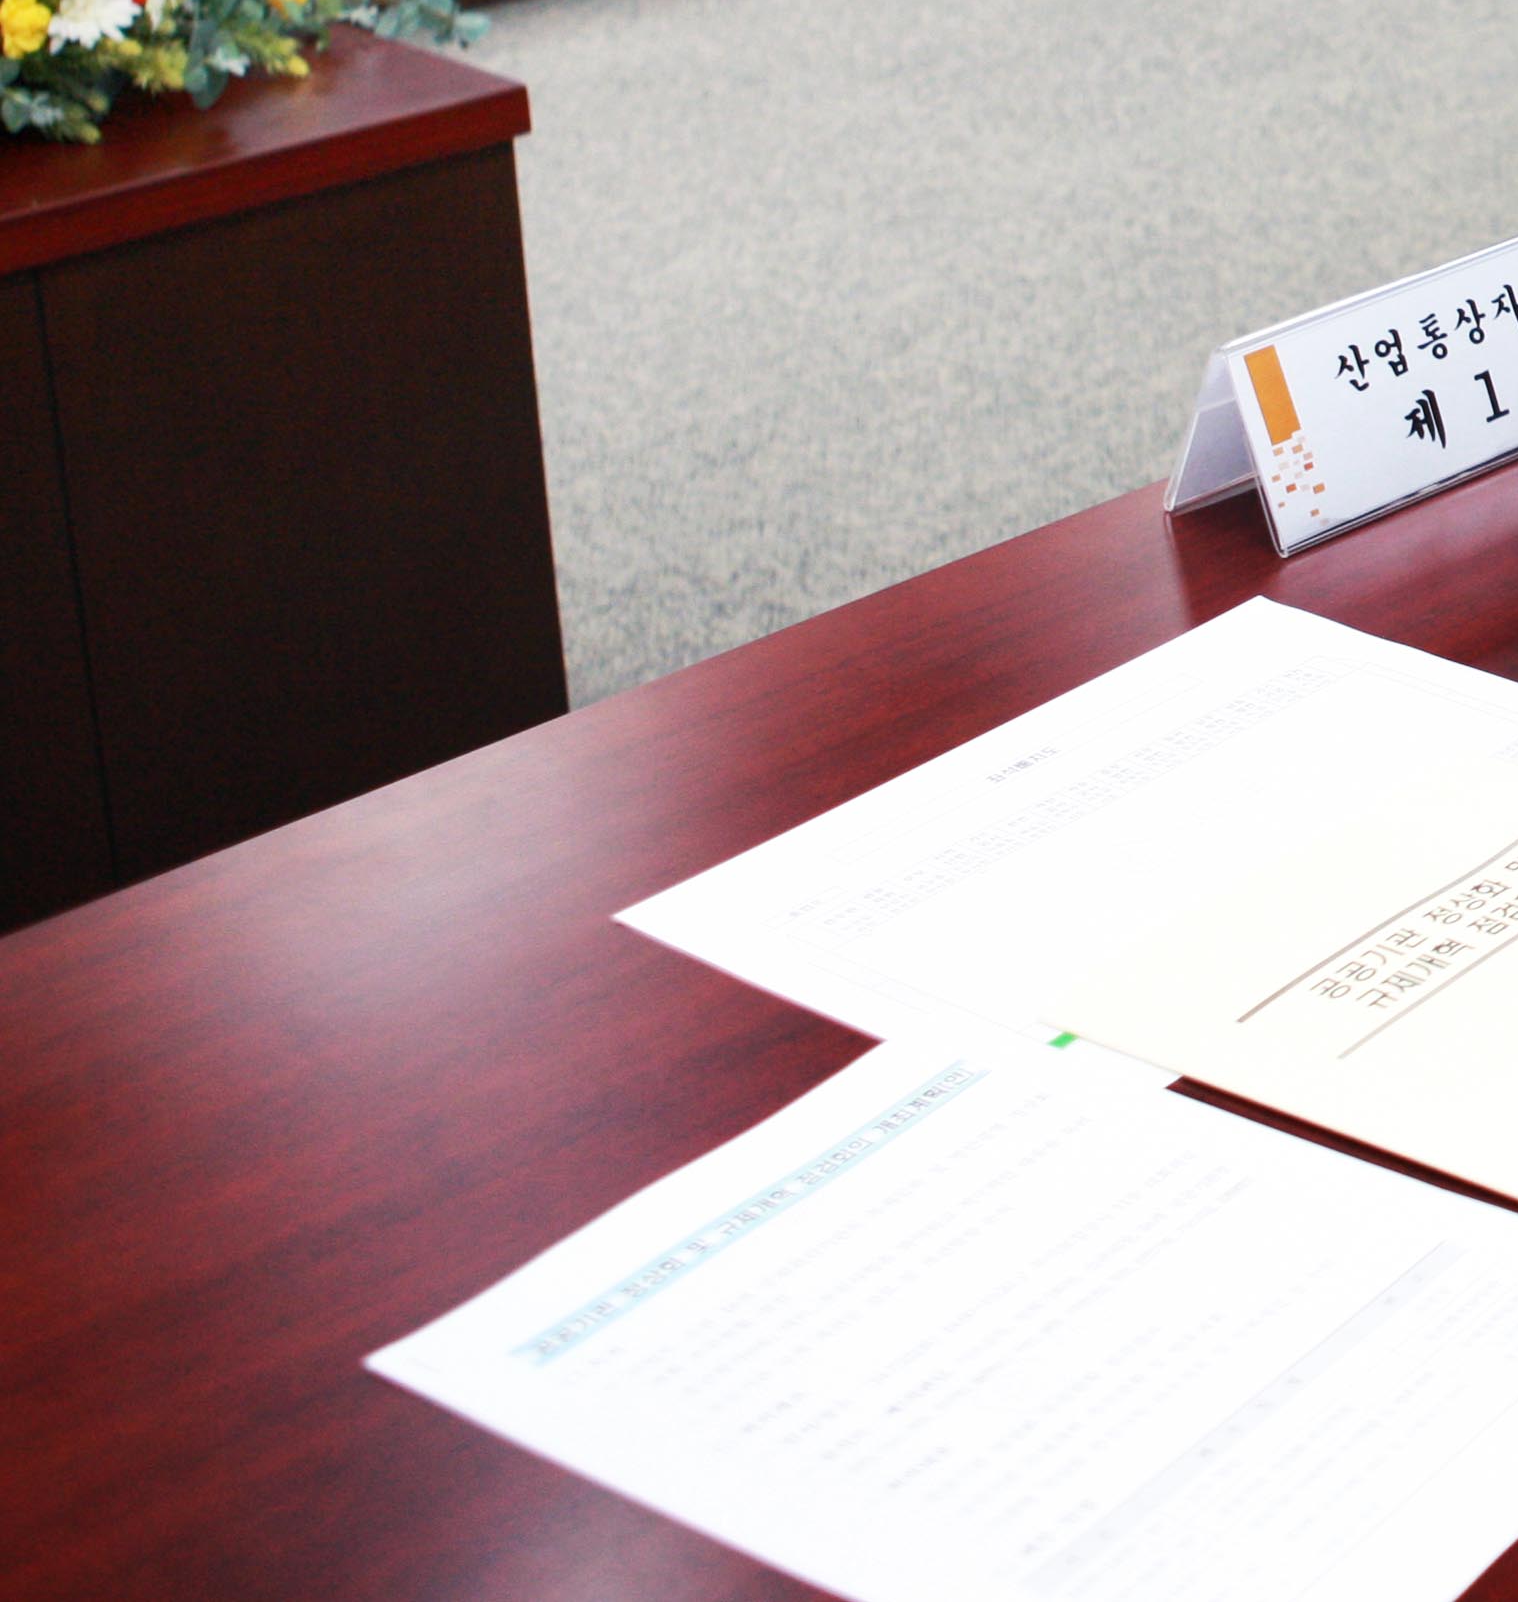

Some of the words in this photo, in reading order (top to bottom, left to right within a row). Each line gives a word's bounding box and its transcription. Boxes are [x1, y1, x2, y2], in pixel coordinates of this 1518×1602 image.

[1403, 388, 1450, 449] 제
[1474, 369, 1510, 423] 1
[1310, 928, 1430, 1000] 공공기관
[1423, 879, 1511, 926] 정상화
[1356, 937, 1480, 1010] 규제개혁
[718, 1186, 796, 1237] 규제개혁
[797, 1137, 875, 1186] 점검회의
